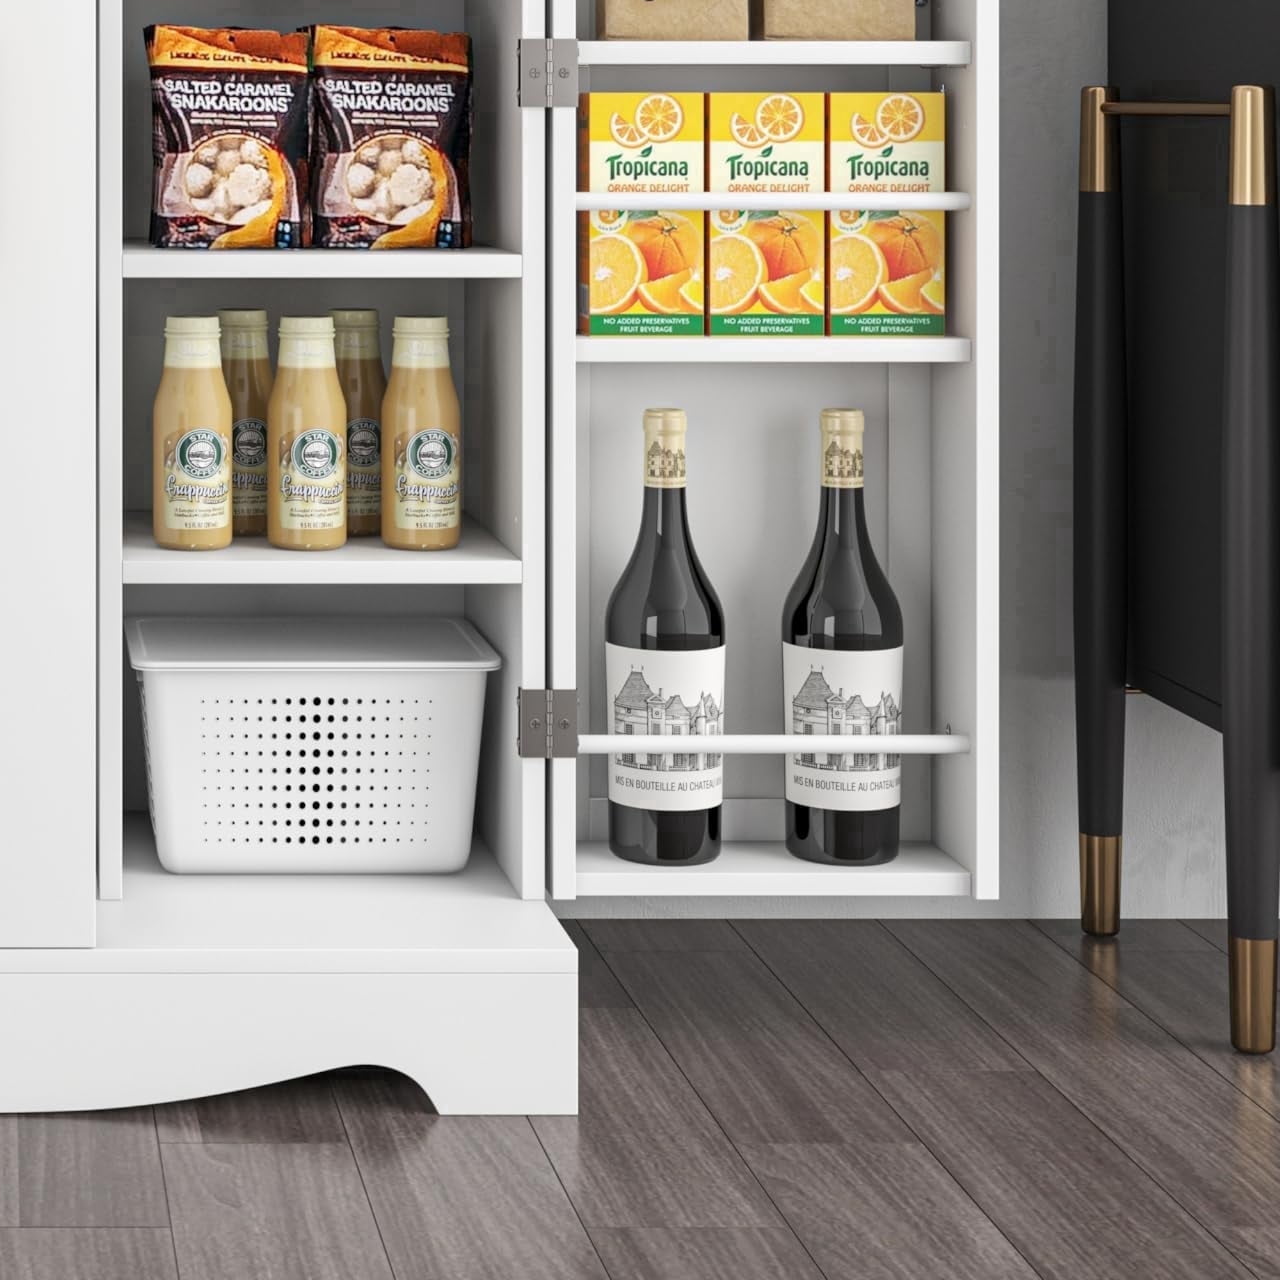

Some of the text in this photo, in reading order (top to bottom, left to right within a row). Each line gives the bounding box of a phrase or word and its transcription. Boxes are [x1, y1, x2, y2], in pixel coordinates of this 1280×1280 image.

[165, 80, 294, 97] SALTED CARAMEL
[326, 80, 455, 97] SALTED CARAMEL
[605, 153, 688, 180] Tropicana
[726, 153, 809, 180] Tropicana
[846, 153, 929, 180] Tropicana
[607, 184, 690, 192] ORANGE DELIGHT
[728, 184, 810, 192] ORANGE DELIGHT
[848, 184, 930, 192] ORANGE DELIGHT
[189, 433, 214, 442] STAR
[305, 433, 330, 441] STAR
[421, 433, 445, 442] STAR
[615, 775, 687, 791] MIS EN BOUTEILLE AU
[793, 775, 868, 792] MIS EN BOUTEILLE AU
